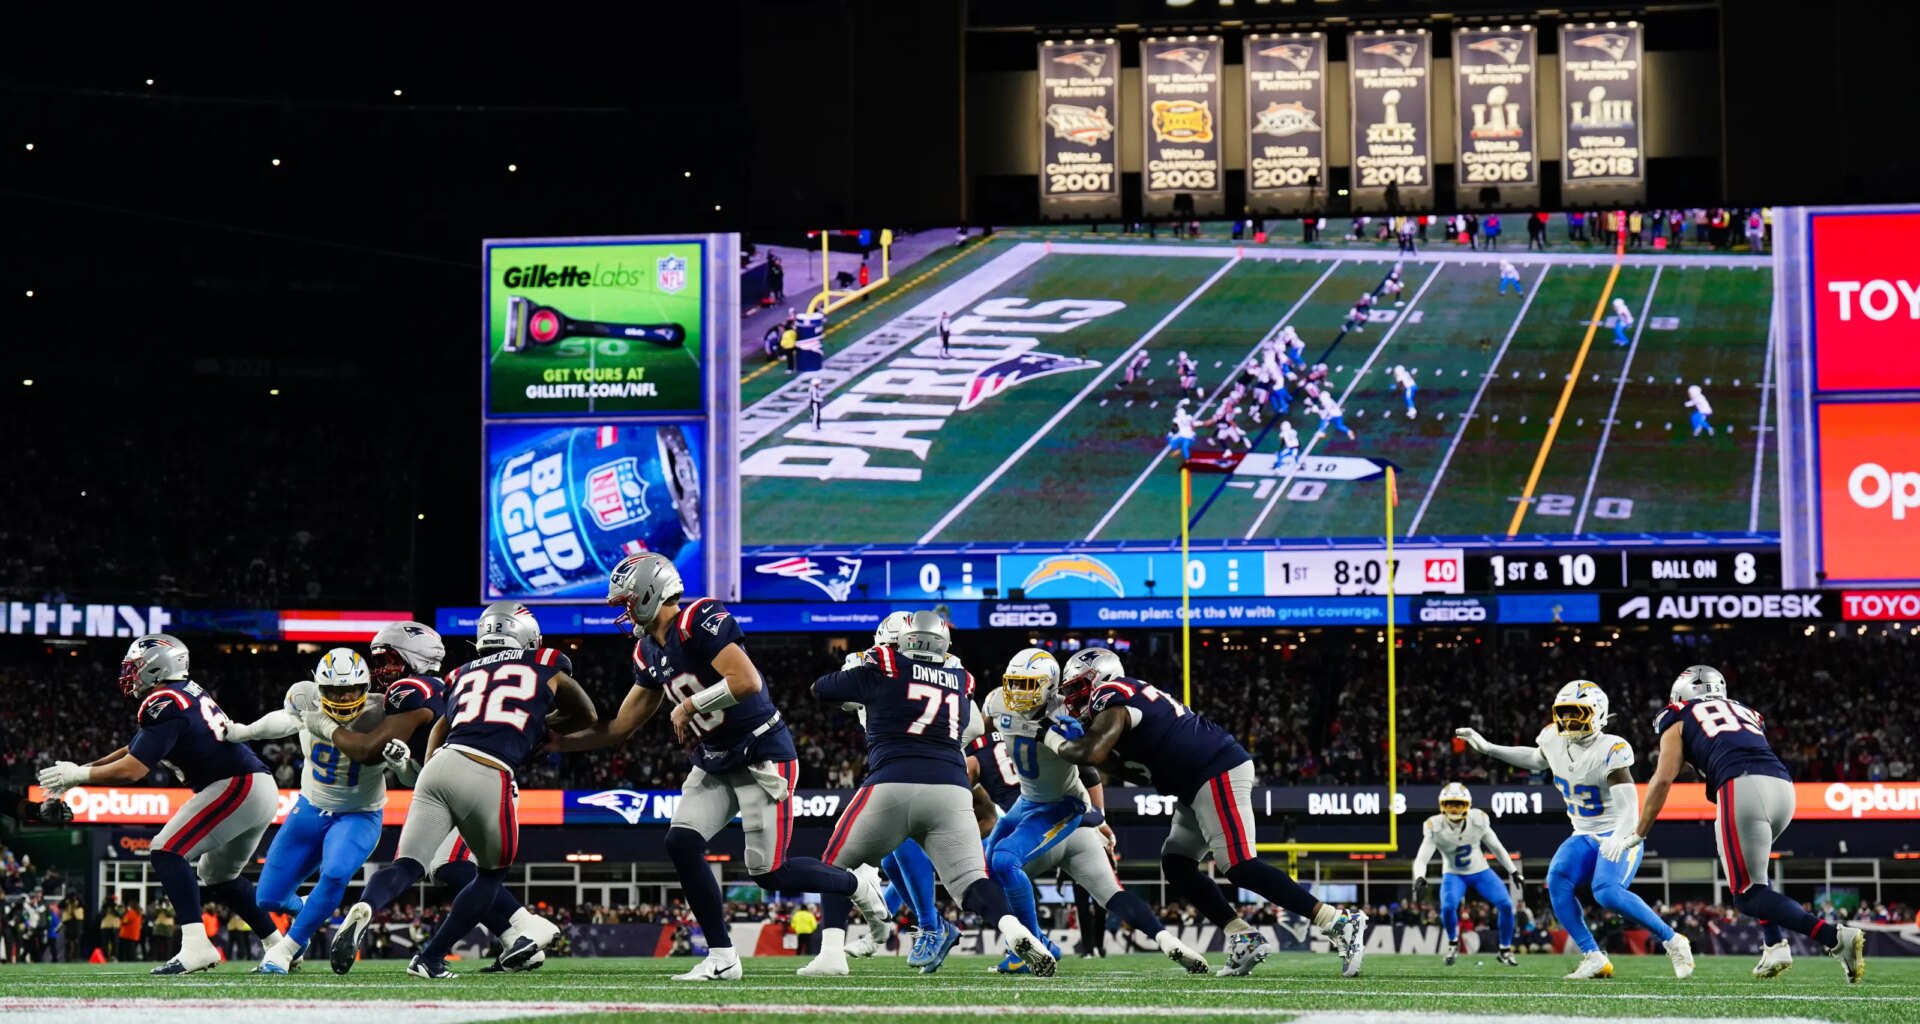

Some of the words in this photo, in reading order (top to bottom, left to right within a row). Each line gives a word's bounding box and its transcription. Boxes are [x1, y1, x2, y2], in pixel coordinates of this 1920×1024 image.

[1379, 68, 1425, 77] ENGLAND
[1485, 64, 1530, 73] ENGLAND
[1591, 60, 1637, 70] ENGLAND
[1069, 77, 1113, 86] ENGLAND
[1172, 73, 1216, 83] ENGLAND
[1275, 71, 1320, 80] ENGLAND
[1363, 77, 1417, 88] PATRIOTS
[1468, 74, 1523, 85] PATRIOTS
[1574, 70, 1629, 81] PATRIOTS
[1053, 86, 1106, 98] PATRIOTS
[1155, 83, 1208, 94] PATRIOTS
[1258, 80, 1313, 91] PATRIOTS
[1368, 144, 1414, 156] WORLD
[1474, 141, 1519, 152] WORLD
[1579, 136, 1626, 148] WORLD
[1057, 152, 1102, 163] WORLD
[1160, 149, 1205, 160] WORLD
[1264, 146, 1309, 157] WORLD
[1462, 152, 1532, 164] CHAMPIONS
[1568, 147, 1638, 160] CHAMPIONS
[1046, 163, 1113, 175] CHAMPIONS
[1149, 160, 1217, 171] CHAMPIONS
[1252, 157, 1321, 169] CHAMPIONS
[1356, 155, 1426, 167] CHAMPIONS
[1573, 158, 1634, 177] 2018
[1150, 170, 1216, 188] 2003
[1361, 166, 1423, 185] 2014
[1467, 162, 1528, 181] 2016
[1050, 174, 1110, 192] 2001
[543, 369, 570, 382] GET
[573, 368, 623, 381] YOURS
[627, 367, 645, 380] AT
[526, 383, 658, 399] GILLETTE.COM/NFL
[740, 297, 1126, 482] PATRIOTS
[592, 470, 623, 523] NFL
[531, 452, 585, 571] BUD
[1535, 493, 1633, 519] 20
[501, 450, 567, 588] LIGHT
[1186, 560, 1206, 589] 0
[1334, 560, 1400, 585] 8:07
[1427, 561, 1456, 580] 40
[1534, 562, 1548, 580] &
[1559, 554, 1596, 586] 10
[1651, 560, 1691, 579] BALL
[1693, 559, 1718, 578] ON
[1734, 552, 1757, 585] 8
[919, 563, 941, 593] 0
[996, 603, 1009, 612] Get
[1009, 604, 1029, 612] more
[1030, 603, 1050, 611] with
[1426, 599, 1441, 607] Get
[1442, 599, 1462, 607] more
[1463, 598, 1479, 606] with
[1656, 595, 1823, 619] AUTODESK
[989, 612, 1058, 627] GEICO
[1098, 607, 1138, 620] Game
[1140, 607, 1173, 622] plan:
[1177, 607, 1201, 619] Get
[1203, 606, 1226, 618] the
[1227, 606, 1244, 618] W
[1245, 606, 1275, 618] with
[1278, 606, 1314, 620] great
[1317, 605, 1383, 620] coverage.
[1420, 607, 1486, 622] GEICO
[470, 649, 525, 669] HENDERSON
[912, 664, 959, 690] ONWENU
[451, 664, 537, 731] 32
[1141, 685, 1194, 718] 7
[199, 695, 232, 741] 6
[907, 683, 960, 741] 71
[1691, 700, 1765, 738] 85
[310, 742, 360, 787] 91
[993, 741, 1021, 785] 6
[1014, 736, 1039, 780] 0
[64, 786, 169, 821] Optum
[1134, 794, 1178, 815] 1ST
[1308, 793, 1352, 815] BALL
[1353, 792, 1379, 815] ON
[1390, 792, 1407, 815] 8
[1491, 792, 1528, 818] QTR
[1531, 792, 1542, 814] 1
[1455, 844, 1472, 868] 2
